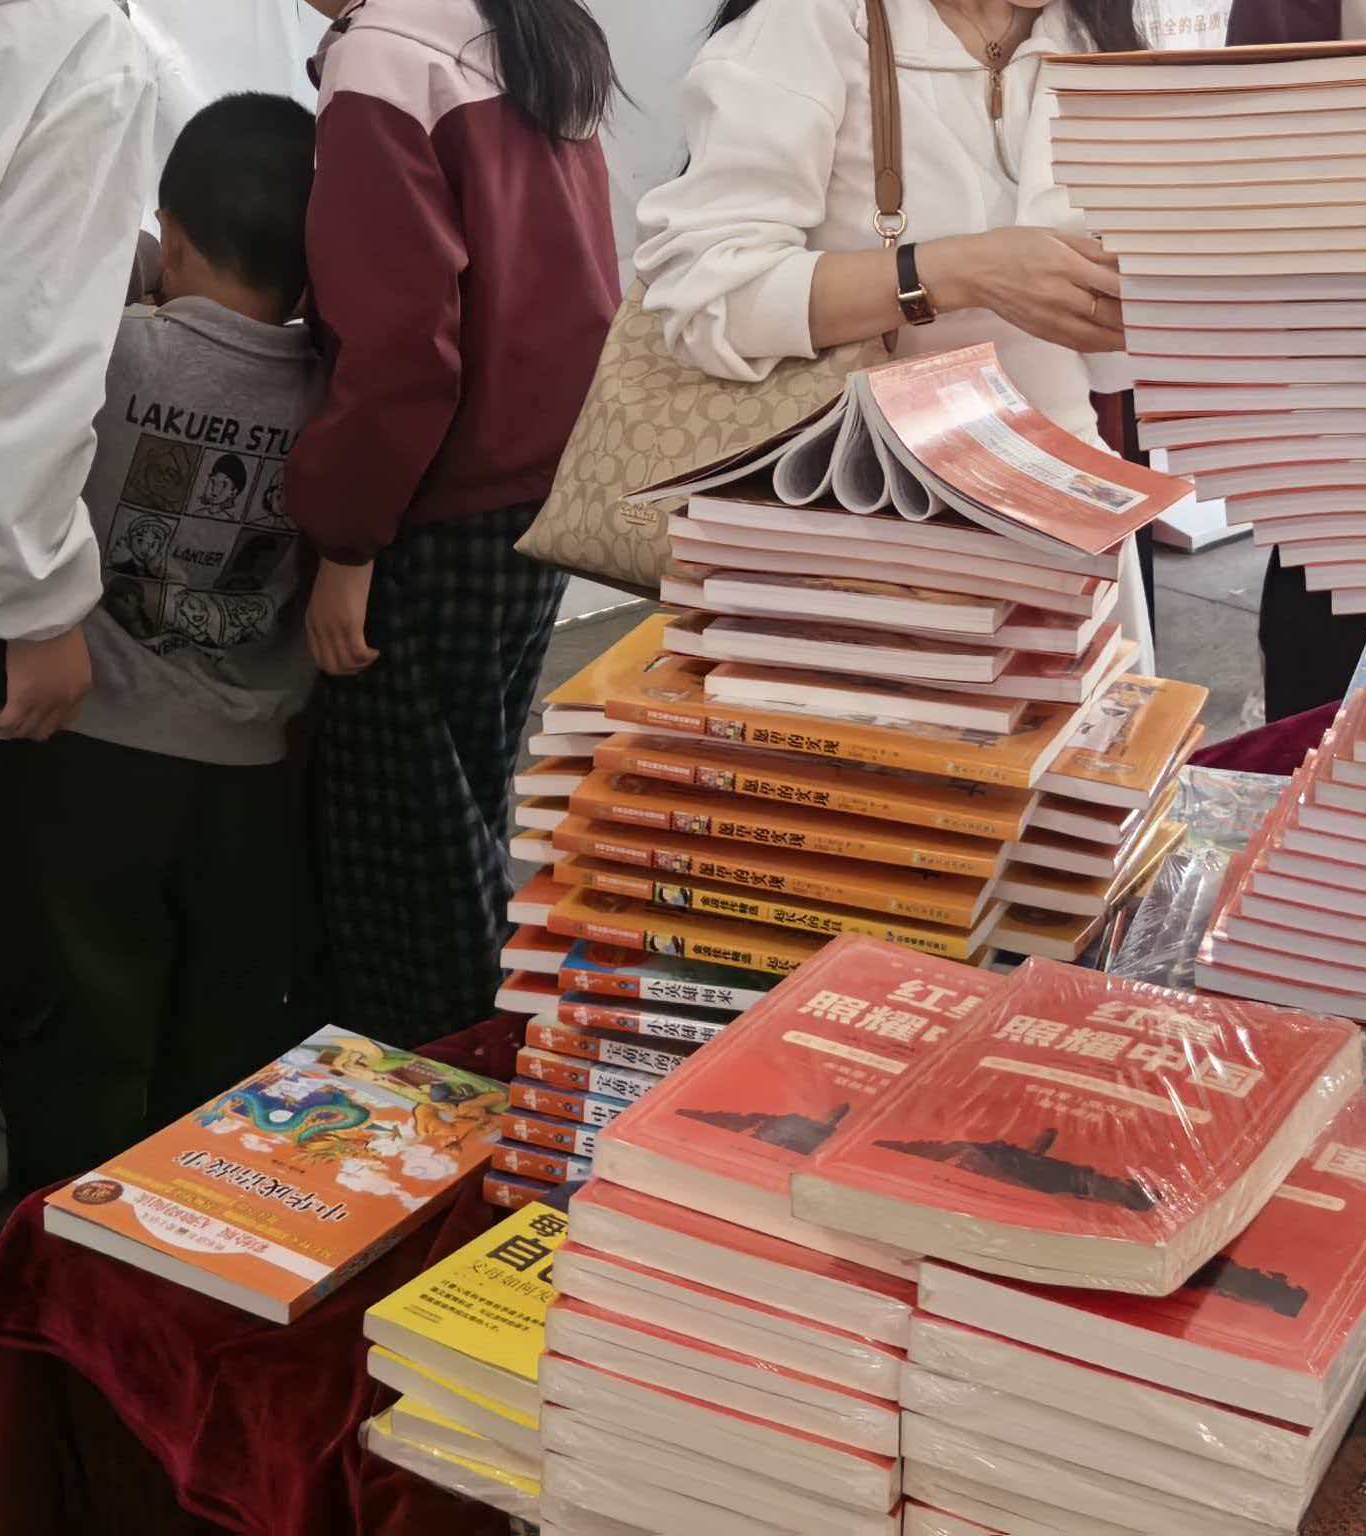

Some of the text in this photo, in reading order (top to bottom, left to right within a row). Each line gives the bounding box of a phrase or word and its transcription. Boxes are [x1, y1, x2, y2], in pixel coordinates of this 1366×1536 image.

[124, 393, 240, 447] LAKUER
[752, 726, 840, 755] 愿望的实现
[741, 777, 831, 808] 愿望的实现
[717, 820, 806, 849] 愿望的实现
[697, 860, 786, 890] 愿望的实现
[647, 978, 734, 1006] 小英雄雨来
[796, 988, 950, 1045] 照耀
[993, 1014, 1266, 1100] 照耀中国
